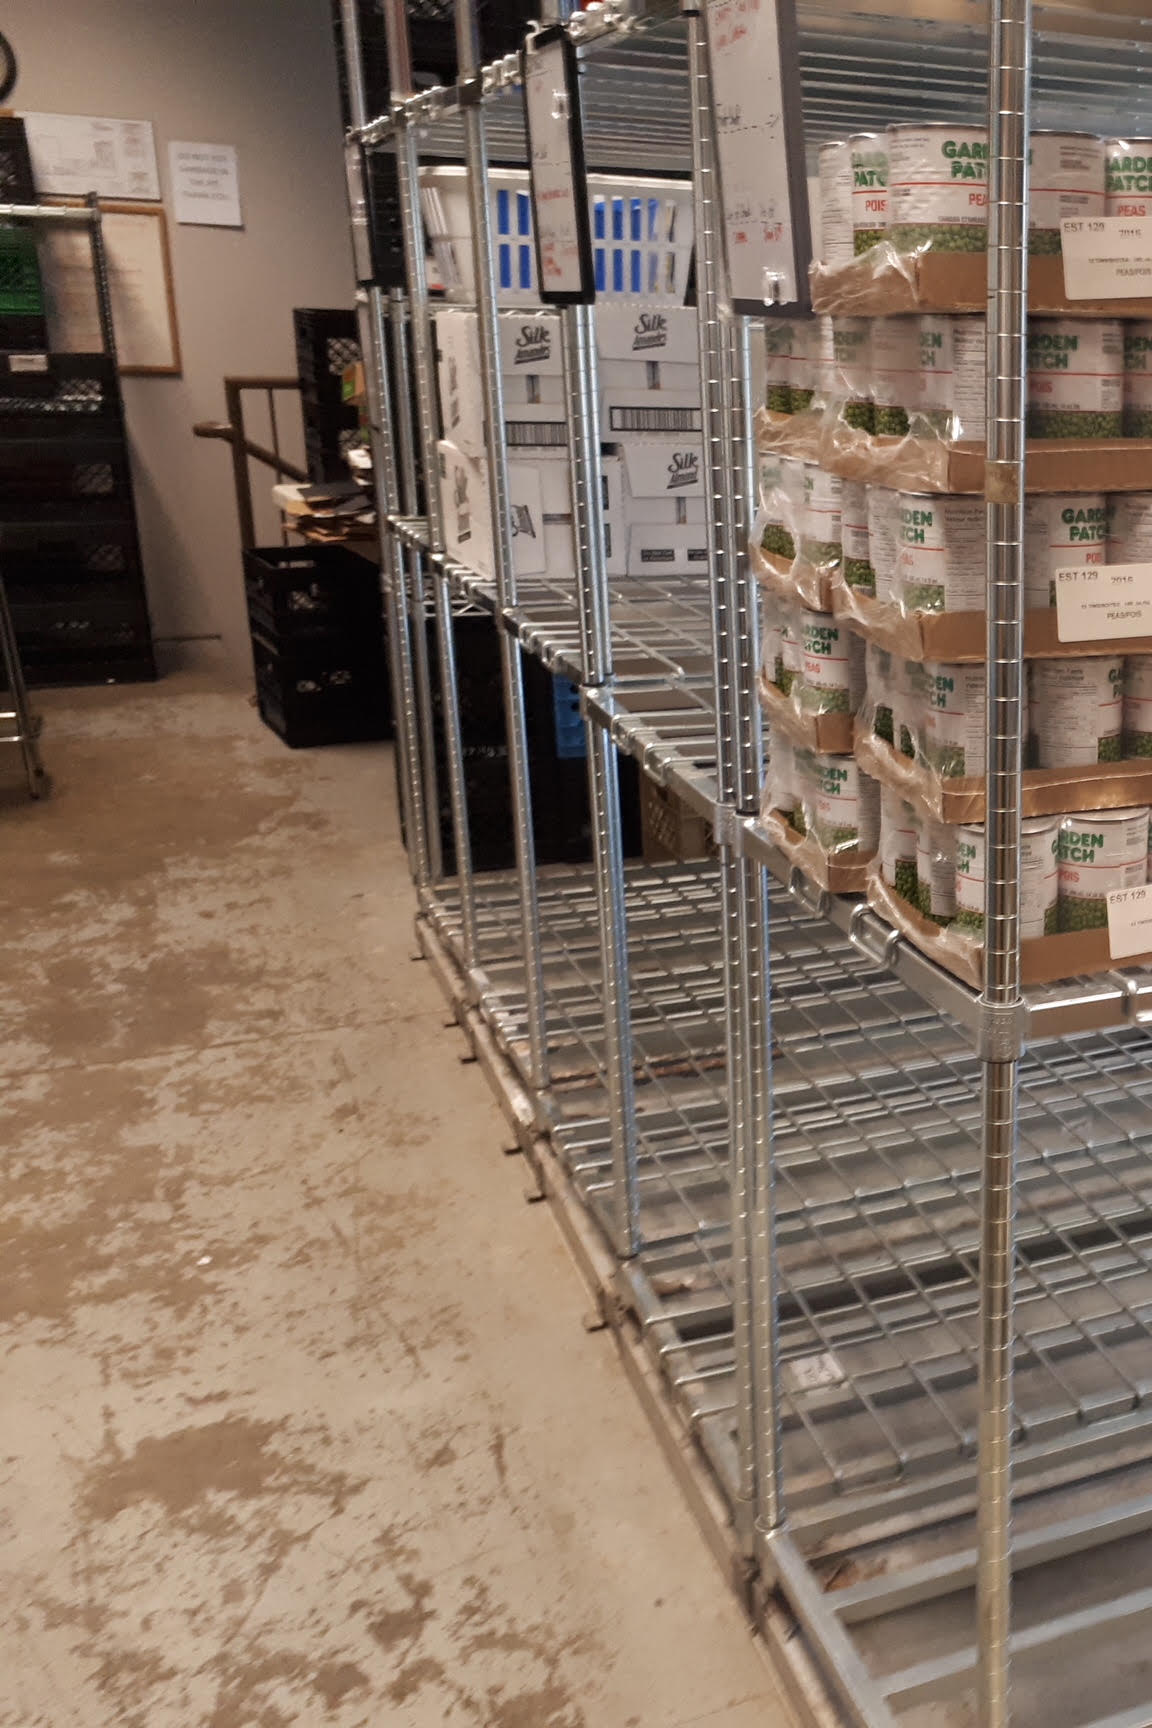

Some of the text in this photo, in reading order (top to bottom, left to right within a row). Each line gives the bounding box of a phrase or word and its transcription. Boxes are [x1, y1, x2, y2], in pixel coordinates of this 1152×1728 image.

[942, 140, 988, 160] GAR
[951, 161, 987, 179] PAT
[1117, 204, 1146, 217] PEAS
[1063, 222, 1084, 233] EST
[634, 313, 667, 334] Silk
[516, 325, 551, 347] Silk
[668, 452, 698, 473] Silk
[1058, 571, 1099, 582] EST 129
[1109, 894, 1128, 904] EST
